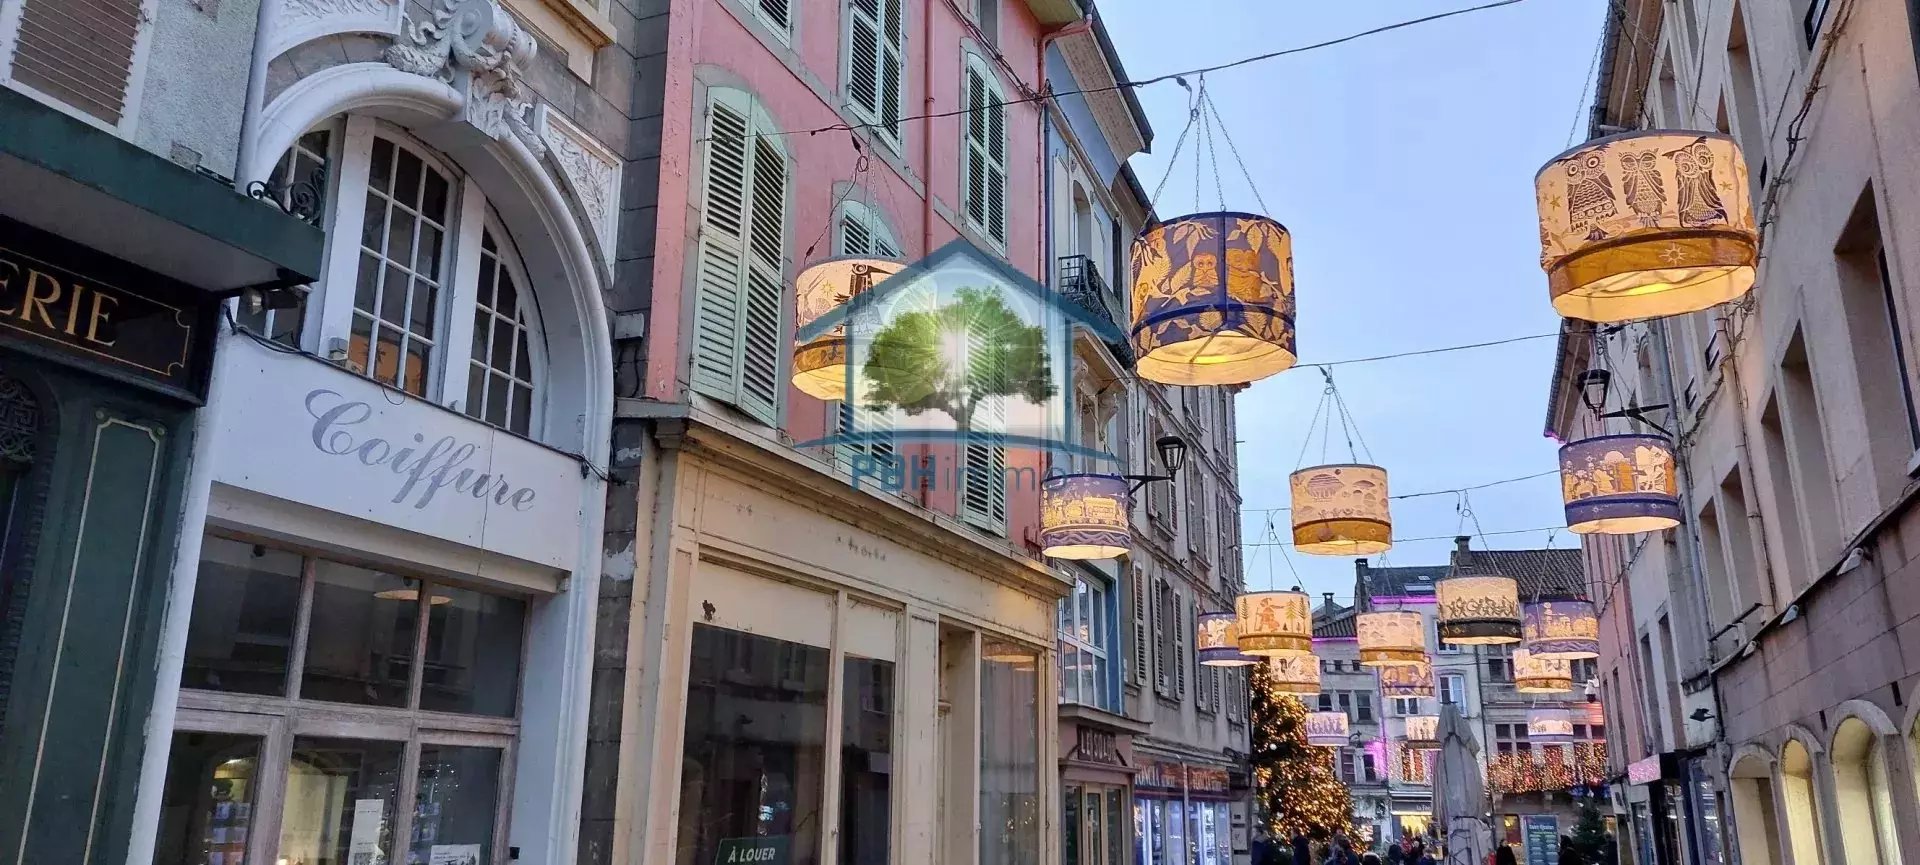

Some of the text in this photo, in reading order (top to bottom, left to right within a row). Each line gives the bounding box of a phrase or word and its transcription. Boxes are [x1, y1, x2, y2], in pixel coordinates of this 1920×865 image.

[305, 388, 536, 512] Coiffure
[727, 845, 776, 863] À LOUER
